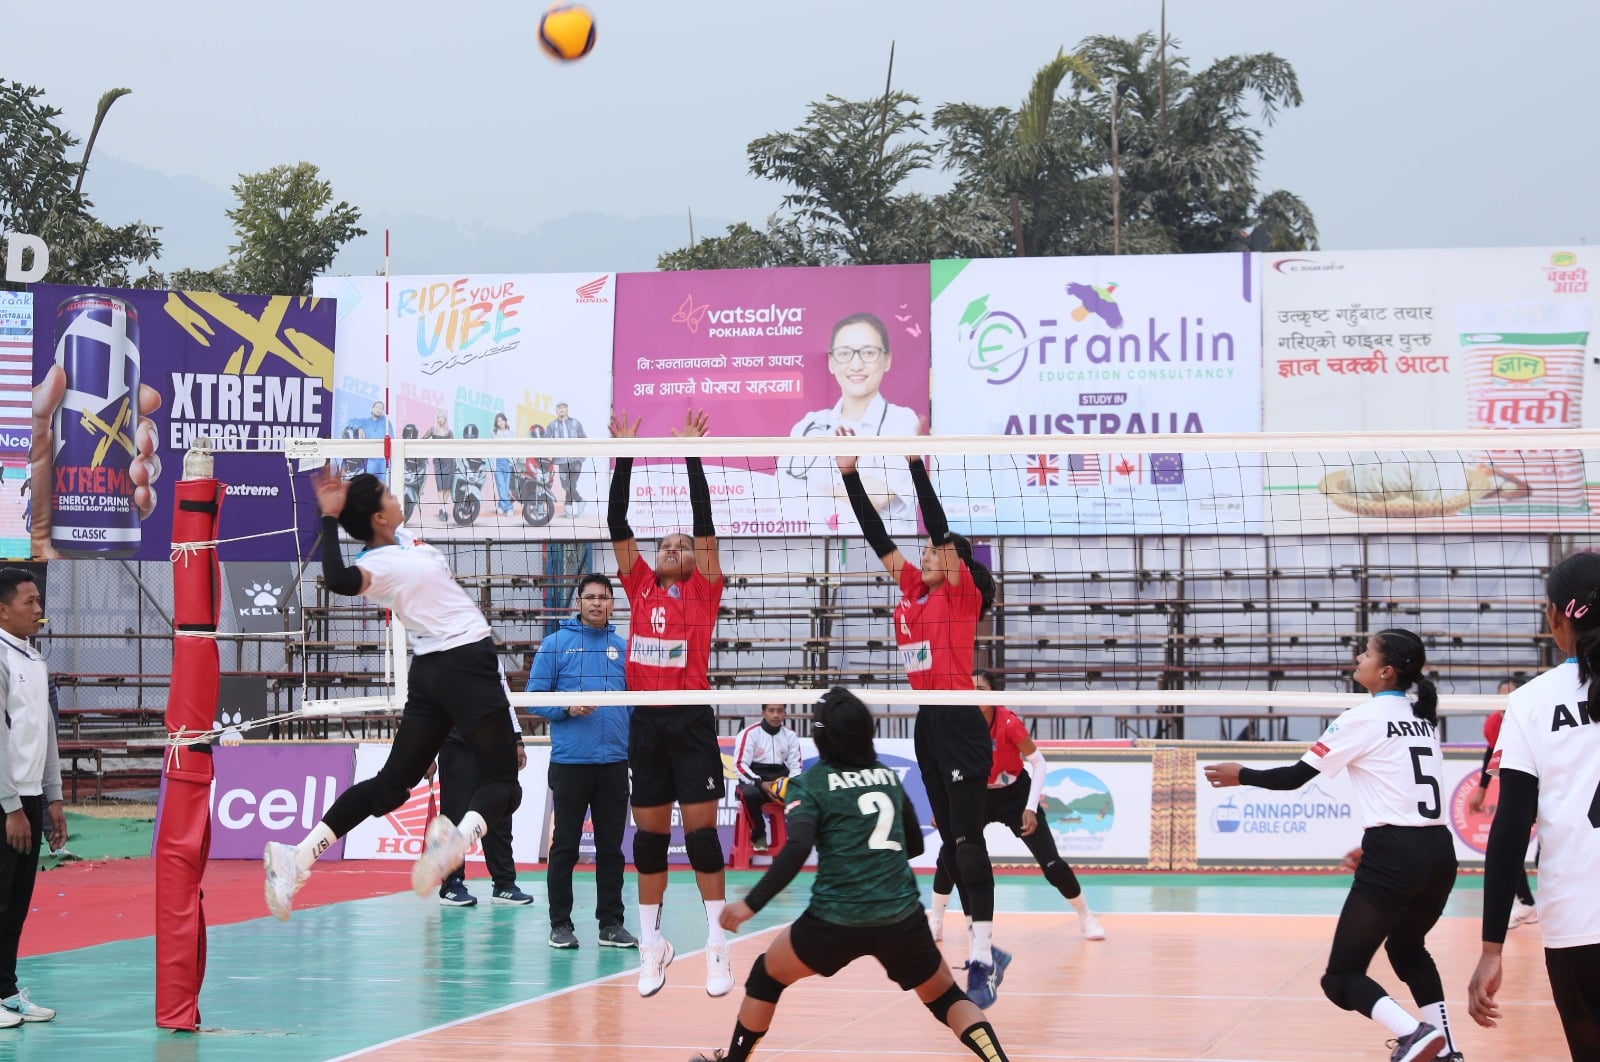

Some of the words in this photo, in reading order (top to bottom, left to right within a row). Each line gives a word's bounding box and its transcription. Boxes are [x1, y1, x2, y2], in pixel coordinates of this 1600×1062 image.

[397, 278, 469, 318] RIDE
[470, 282, 514, 304] YOUR
[707, 303, 802, 327] vatsalya
[1394, 306, 1434, 320] तयार
[416, 295, 525, 357] VIBE
[708, 327, 764, 338] POKHARA
[766, 325, 803, 336] CLINIC
[1039, 316, 1235, 365] Franklin
[1278, 331, 1336, 352] गरिएको
[1342, 333, 1394, 350] फाइबर
[731, 356, 764, 368] सफल
[1277, 358, 1320, 378] ज्ञान
[1326, 349, 1388, 375] चक्की
[1395, 355, 1449, 374] आटा
[1039, 370, 1121, 382] EDUCATION
[1128, 367, 1235, 380] CONSULTANCY
[171, 372, 323, 423] XTREME
[400, 381, 444, 406] SLAY
[633, 382, 655, 396] अब
[701, 377, 741, 394] पोखरा
[456, 385, 505, 412] AURA
[524, 388, 552, 412] LIT
[1082, 394, 1111, 405] STUDY
[1113, 393, 1125, 404] IN
[59, 495, 97, 506] ENERGY
[99, 496, 129, 507] DRINK
[659, 485, 688, 496] TIKA
[709, 484, 744, 496] RUNG
[72, 528, 107, 539] CLASSIC
[732, 520, 807, 534] 9701021111
[651, 606, 666, 634] 16
[1386, 720, 1436, 740] ARMY
[827, 767, 897, 792] ARMY
[1408, 746, 1441, 819] 5
[209, 776, 337, 831] cell
[1243, 803, 1352, 819] ANNAPURNA
[857, 791, 903, 851] 2
[1243, 820, 1280, 833] CABLE
[1283, 820, 1307, 833] CAR
